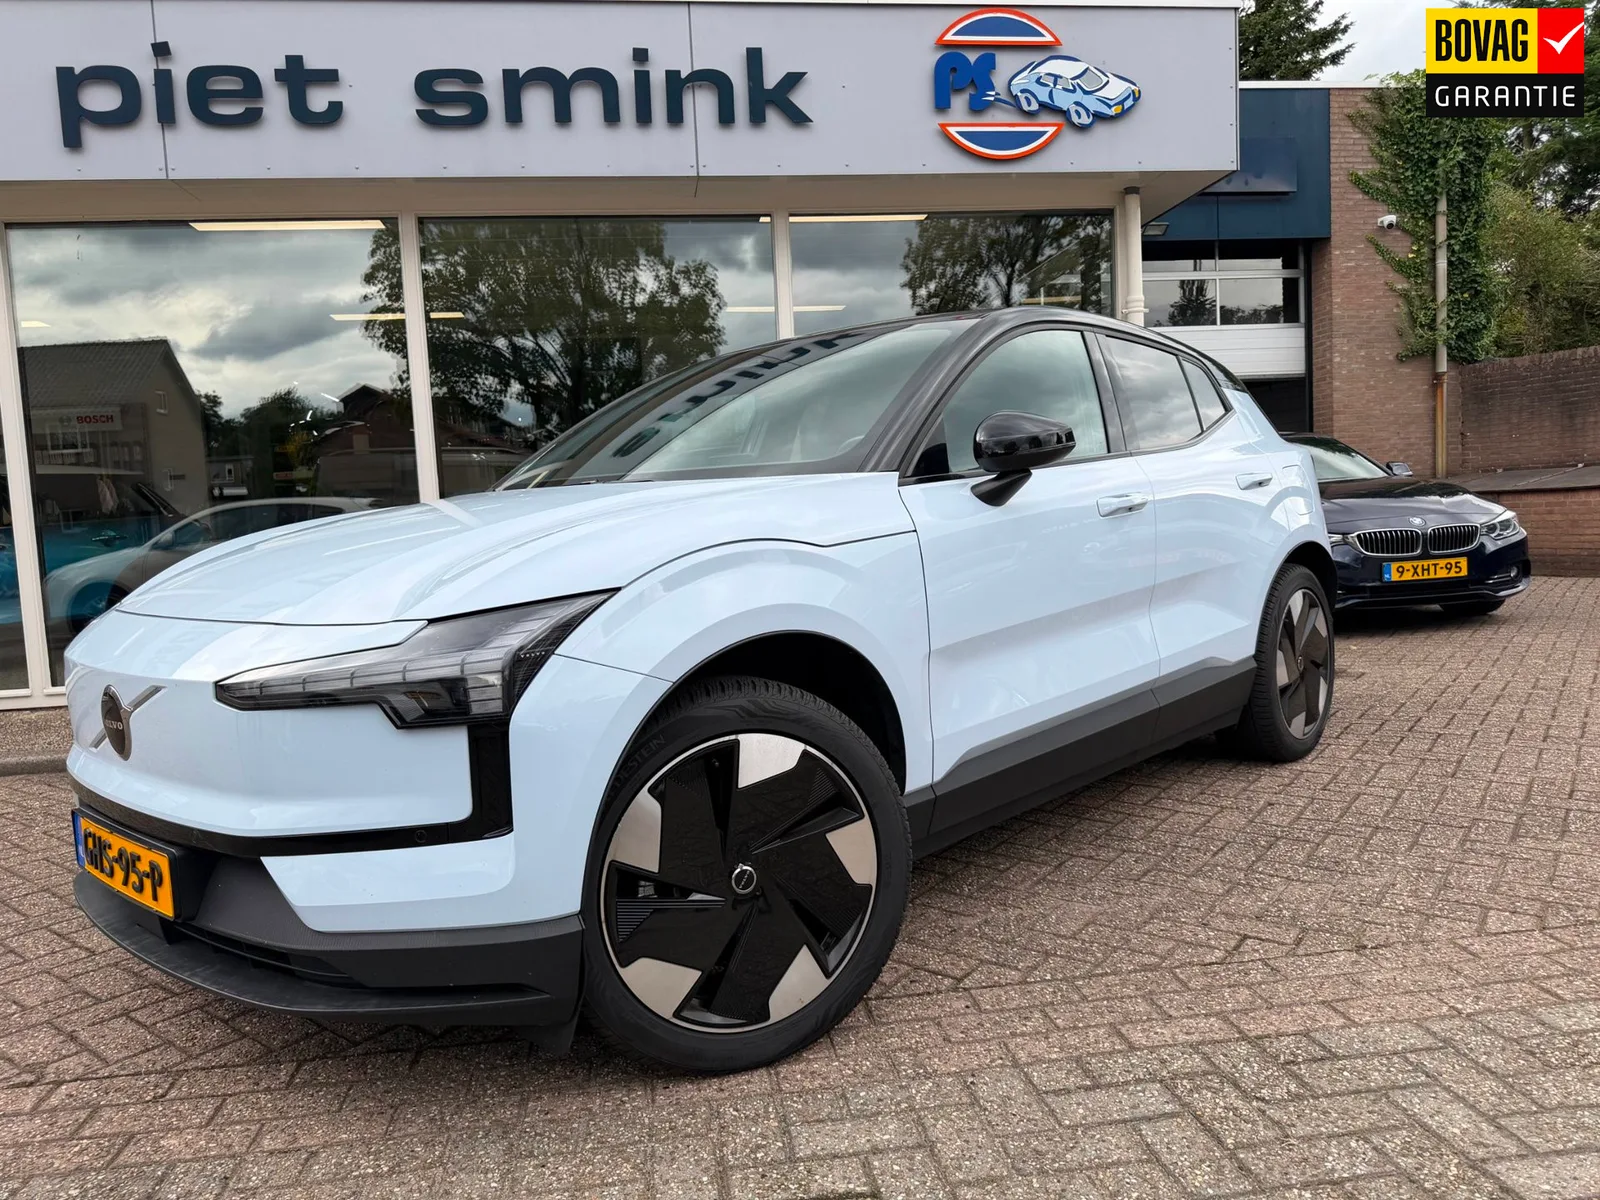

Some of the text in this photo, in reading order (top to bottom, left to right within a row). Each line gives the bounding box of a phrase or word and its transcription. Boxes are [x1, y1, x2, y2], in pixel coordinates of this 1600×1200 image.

[56, 41, 813, 147] piet smink
[76, 414, 114, 424] BOSCH
[1396, 561, 1462, 578] 9-XHT-95
[84, 828, 163, 902] GHS-95-P
